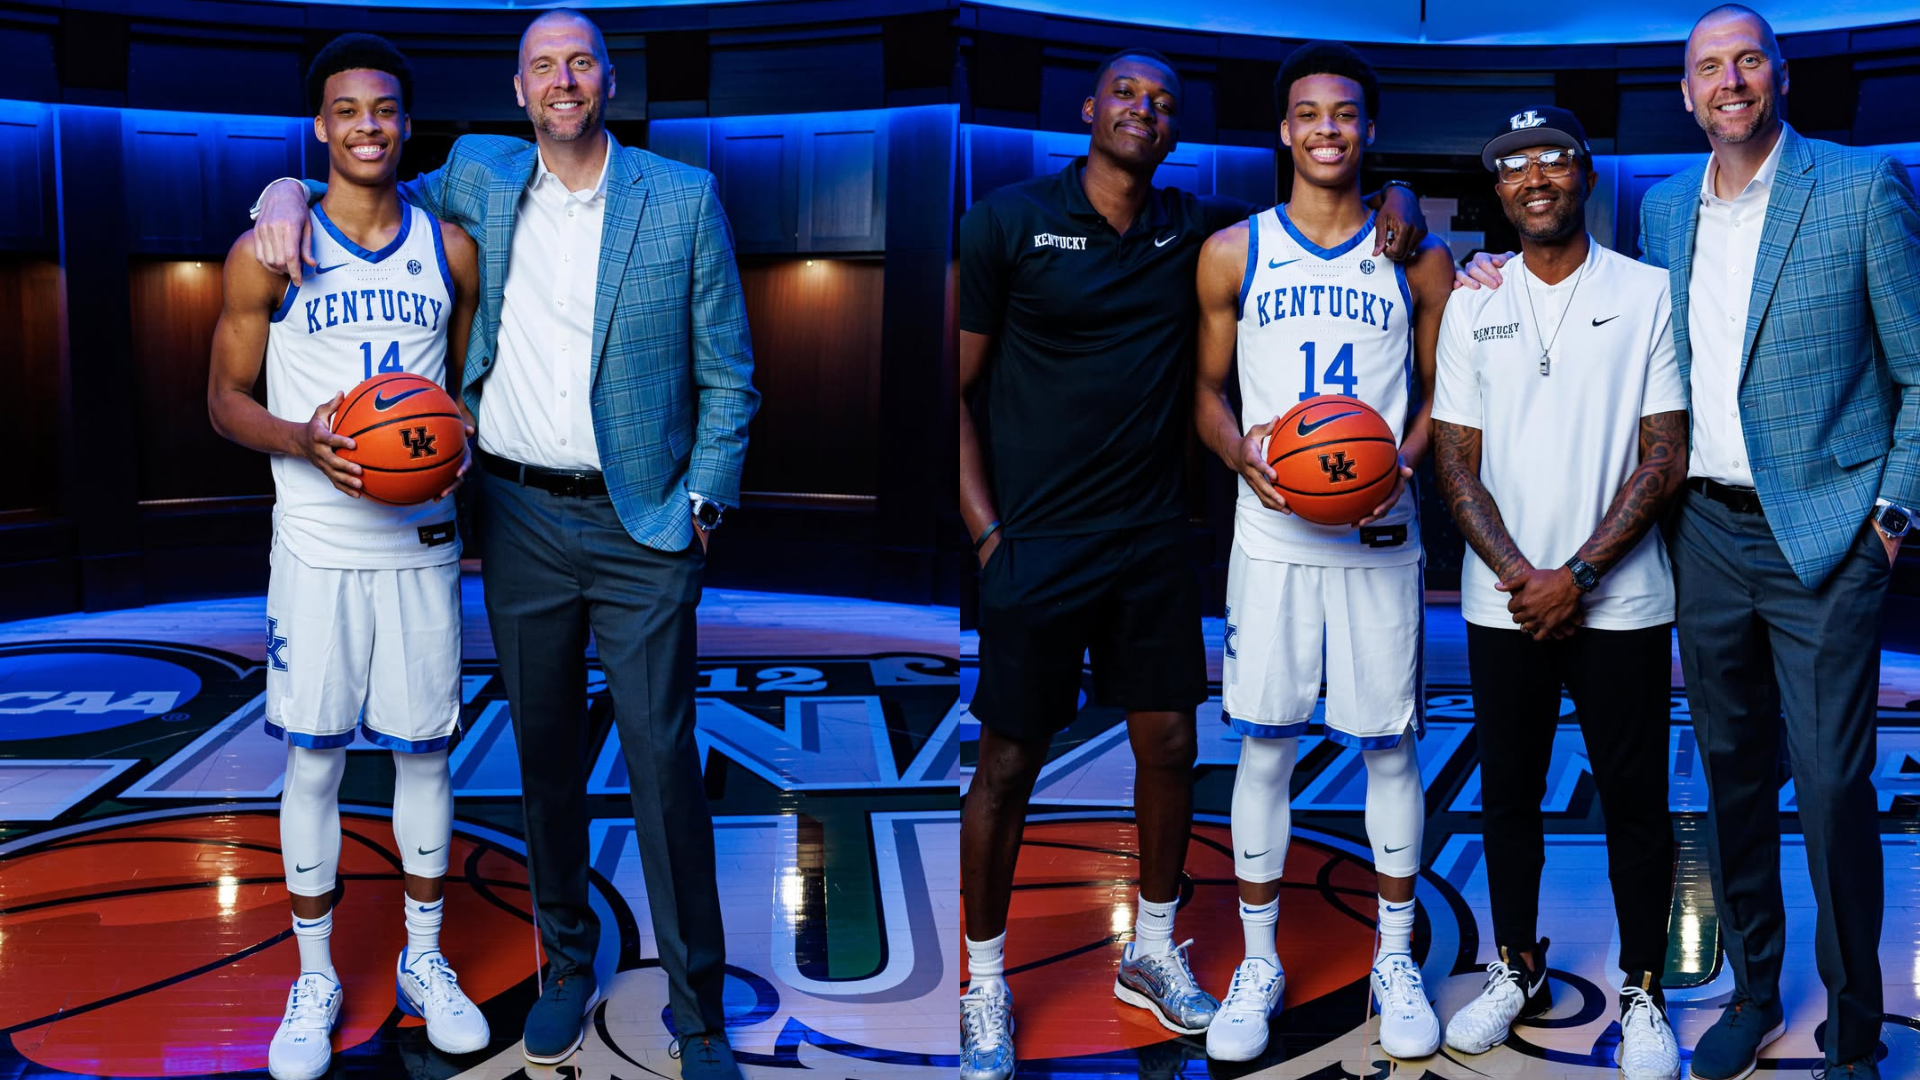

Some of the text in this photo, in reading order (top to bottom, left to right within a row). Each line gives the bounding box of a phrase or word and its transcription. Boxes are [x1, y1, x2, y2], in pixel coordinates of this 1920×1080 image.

[1034, 232, 1087, 250] KENTUCKY
[305, 289, 442, 334] KENTUCKY
[1257, 285, 1394, 331] KENTUCKY
[1473, 322, 1520, 340] KENTUCKY
[359, 341, 403, 383] 14
[1299, 341, 1358, 402] 14
[399, 426, 437, 459] UK
[1318, 451, 1357, 483] UK
